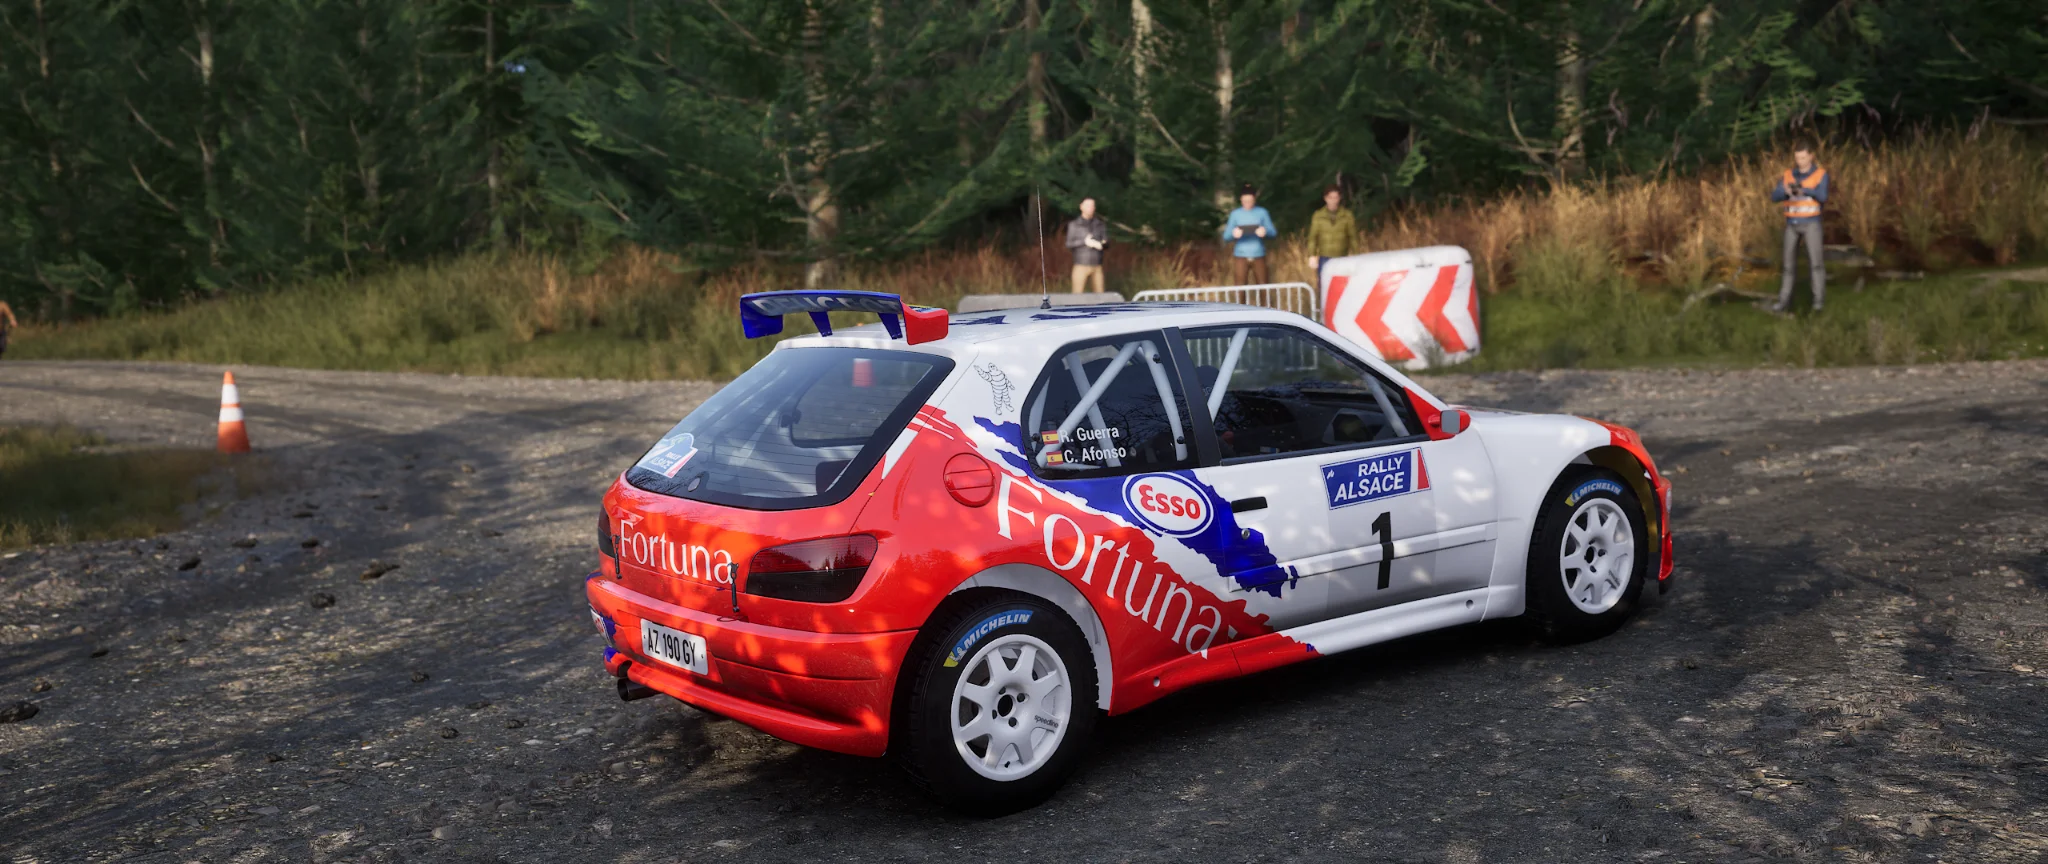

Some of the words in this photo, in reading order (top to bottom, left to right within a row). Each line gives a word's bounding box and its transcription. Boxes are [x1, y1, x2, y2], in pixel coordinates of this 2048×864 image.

[1060, 430, 1074, 443] R.
[1076, 427, 1120, 442] Guerra
[1064, 449, 1078, 464] C.
[1082, 446, 1126, 462] Afonso
[1358, 456, 1405, 477] RALLY
[1334, 472, 1405, 502] ALSACE
[1580, 482, 1621, 496] MICHELIN
[620, 519, 735, 585] Fortuna
[997, 472, 1222, 660] Fortuna
[1371, 511, 1395, 591] 1
[648, 628, 660, 655] AZ
[662, 633, 680, 661] 190
[682, 639, 696, 667] GY
[963, 613, 1031, 649] MICHELIN
